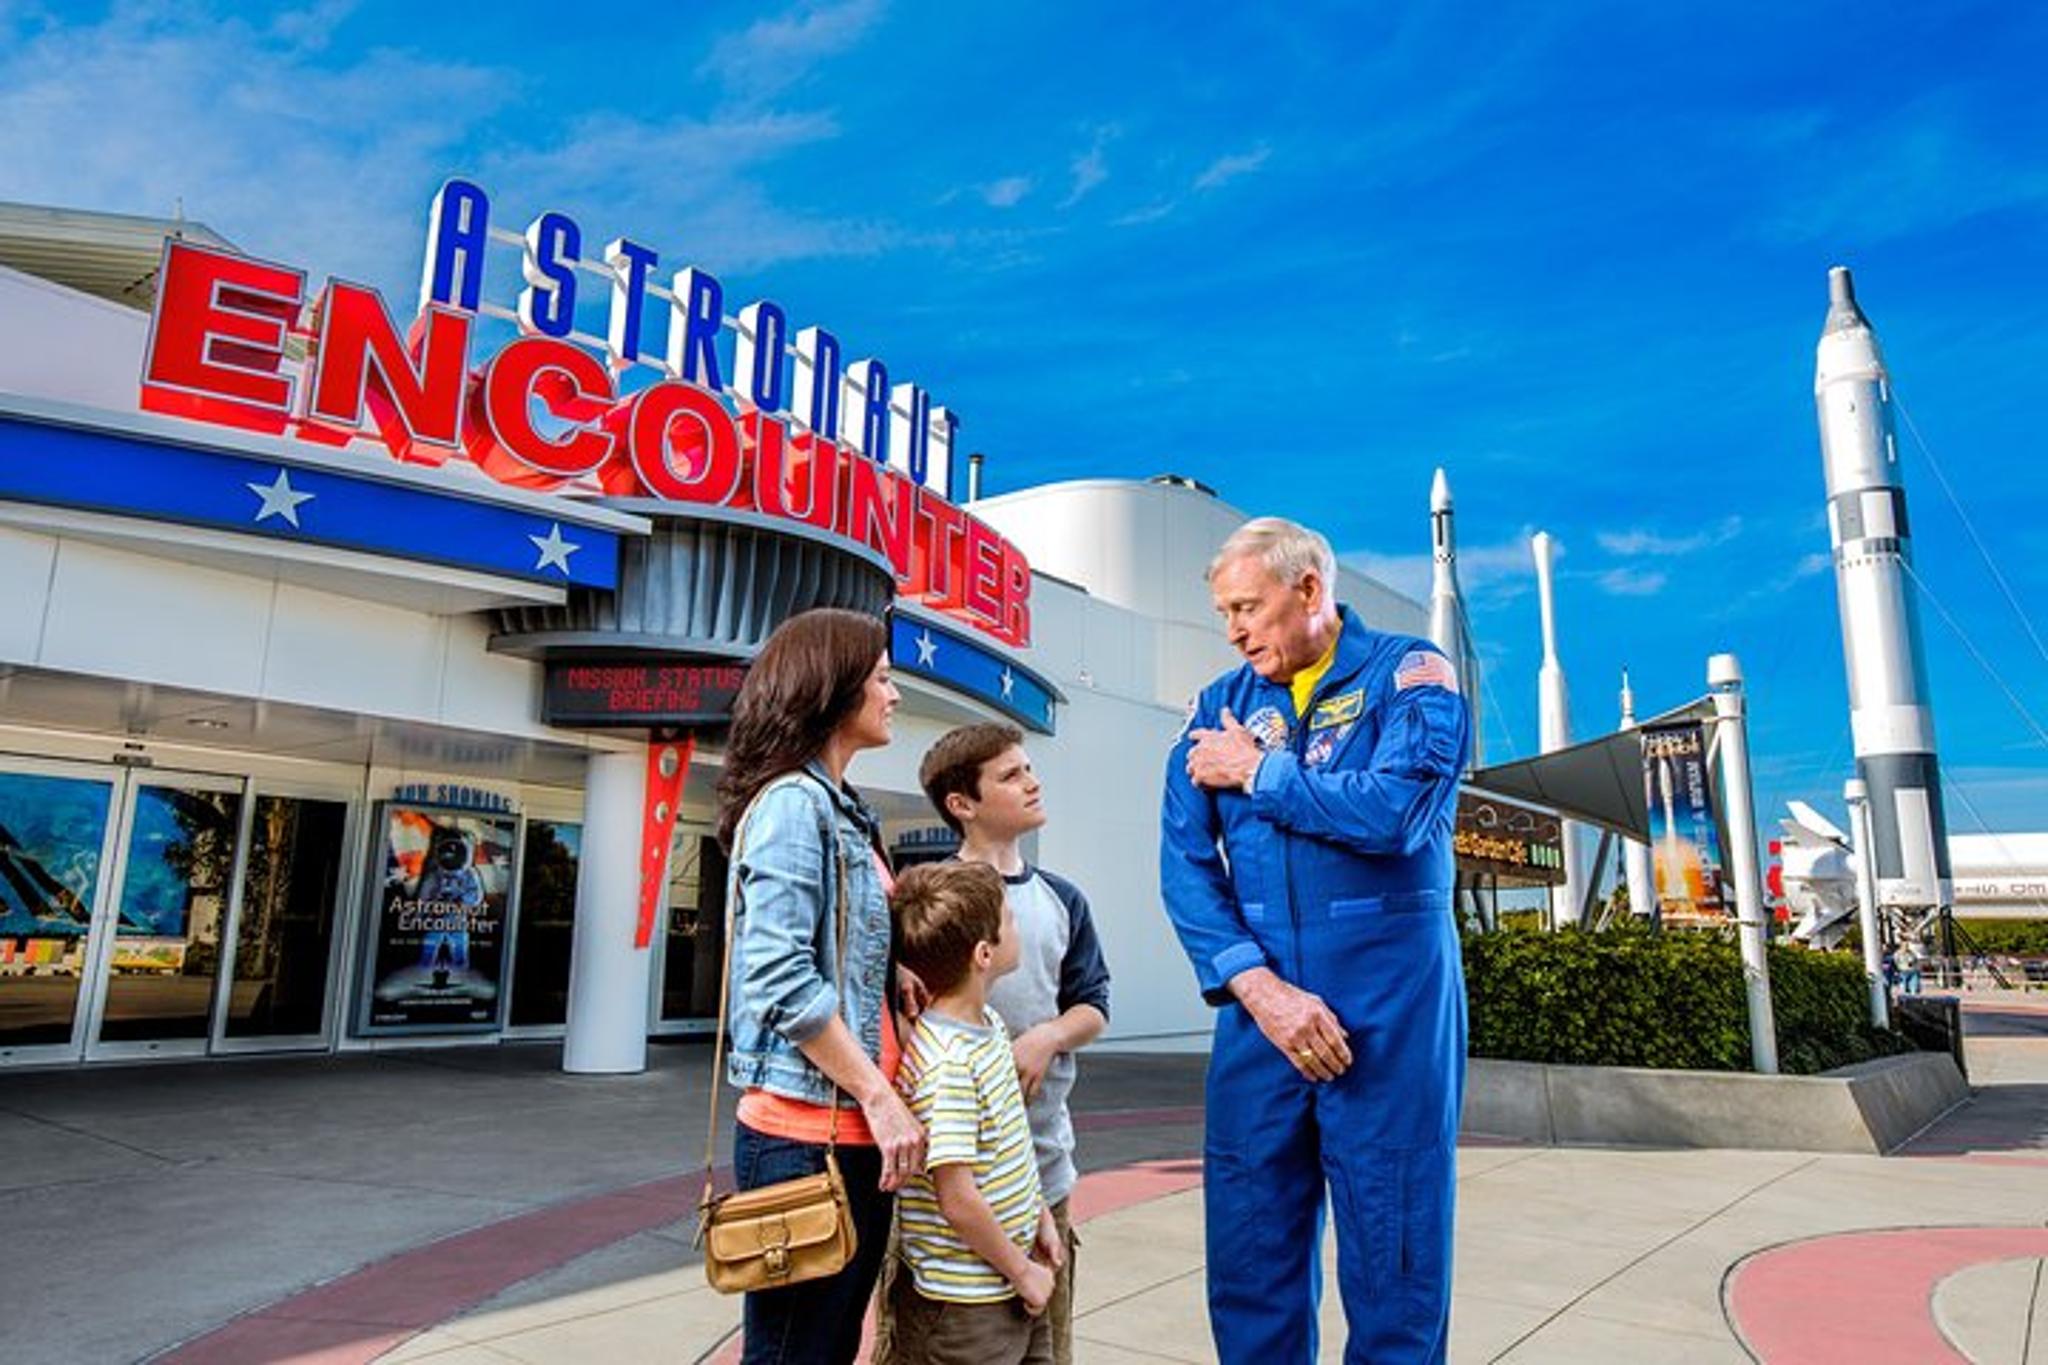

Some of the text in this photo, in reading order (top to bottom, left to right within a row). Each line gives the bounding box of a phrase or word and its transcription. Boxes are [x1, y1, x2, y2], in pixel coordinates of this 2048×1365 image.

[424, 178, 959, 500] ASTRONAUT
[141, 237, 1031, 646] ENCOUNTER
[568, 667, 743, 689] MISSION STATUS
[608, 691, 699, 711] BRIEFING
[398, 911, 499, 933] Encounter
